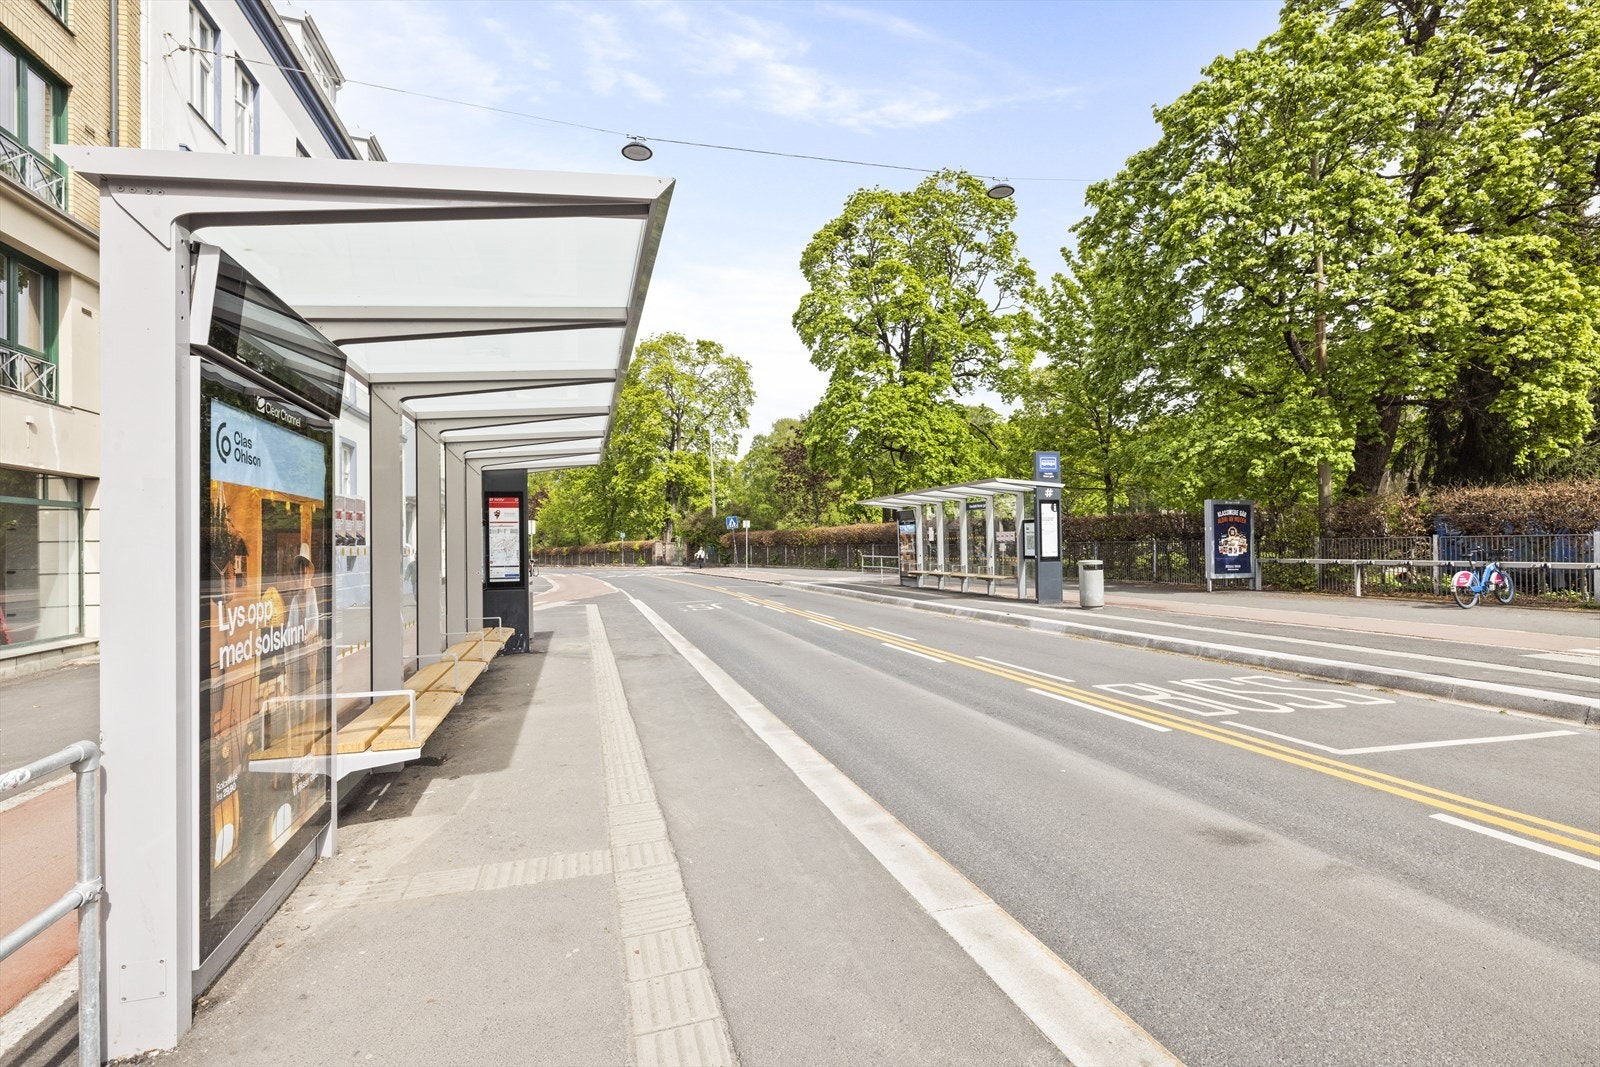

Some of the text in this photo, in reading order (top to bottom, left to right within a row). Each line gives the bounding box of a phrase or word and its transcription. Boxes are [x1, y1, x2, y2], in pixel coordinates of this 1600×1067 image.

[266, 402, 301, 427] Clear Channel
[234, 431, 253, 449] Clas
[234, 447, 261, 467] Ohlson
[218, 600, 273, 636] Lys opp
[219, 617, 307, 670] med solskinn!
[1092, 676, 1396, 717] BUSS
